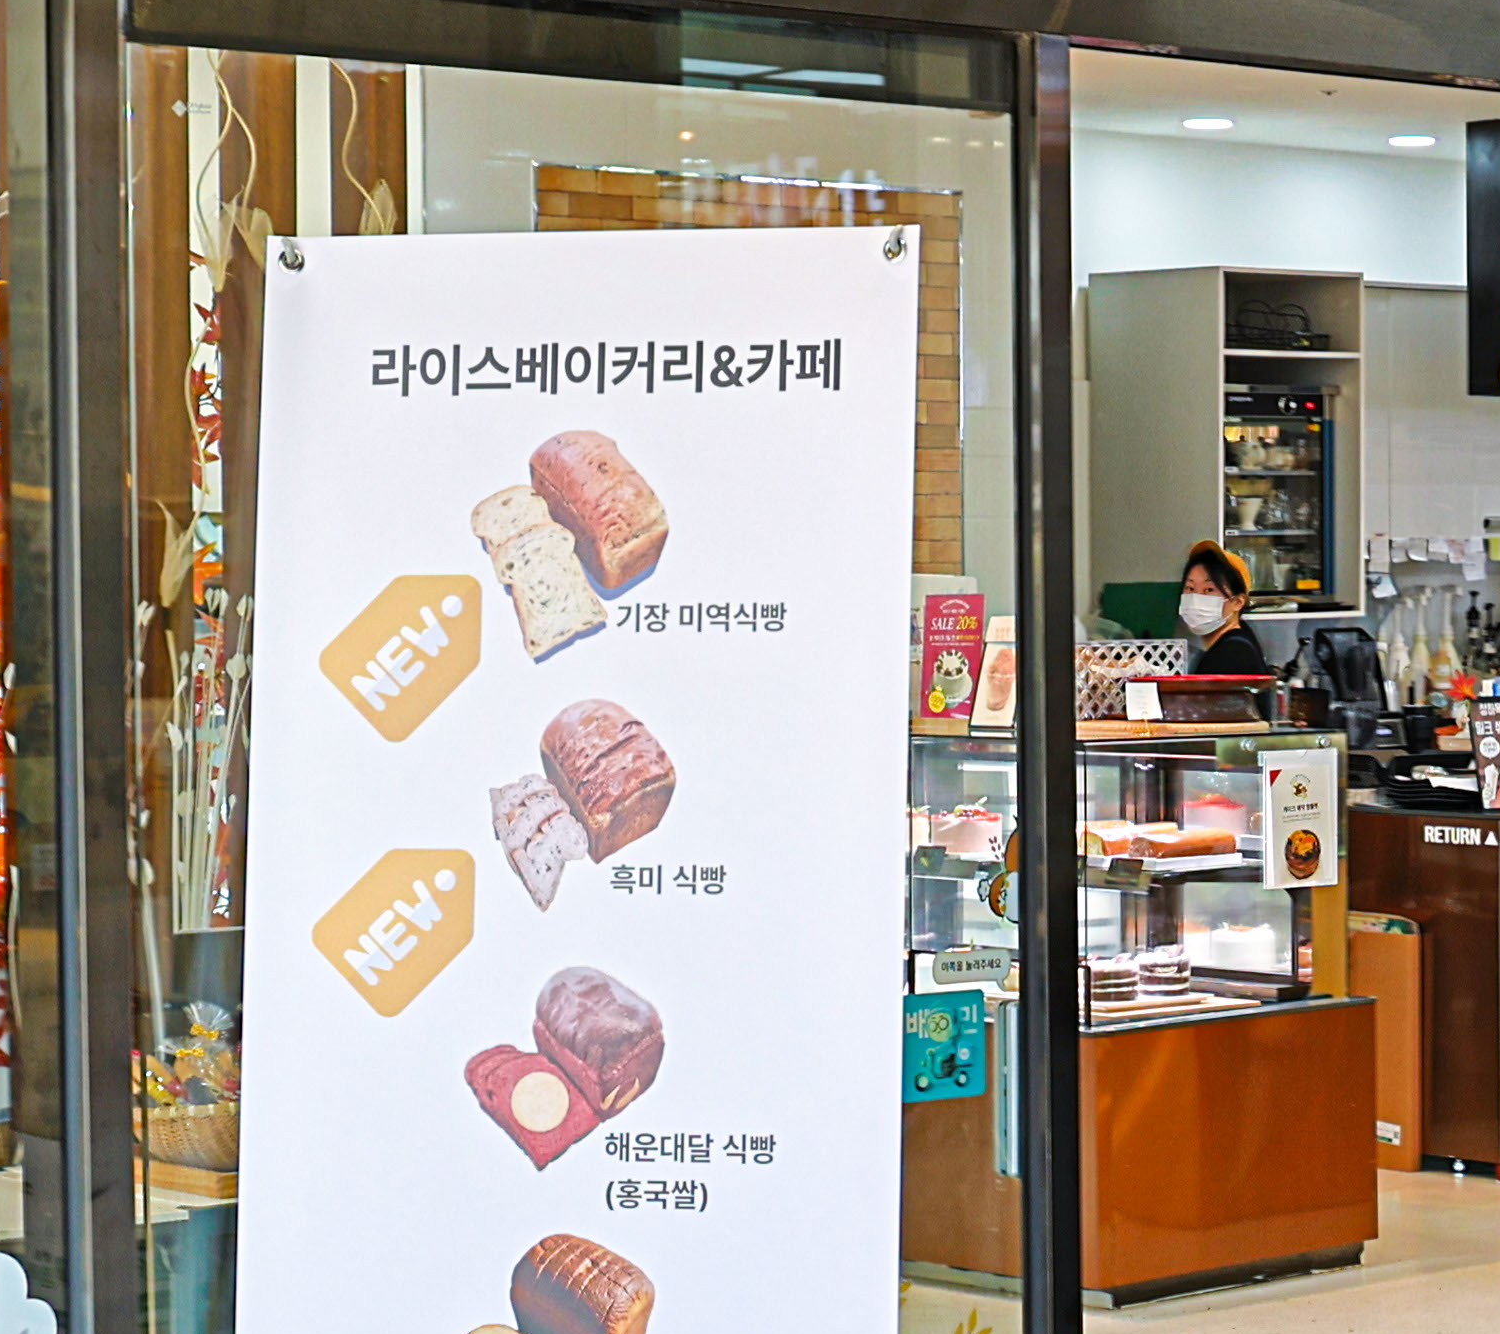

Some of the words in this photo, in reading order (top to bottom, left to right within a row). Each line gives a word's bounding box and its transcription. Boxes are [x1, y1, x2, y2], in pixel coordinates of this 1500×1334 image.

[371, 337, 843, 397] 라이스베이커리&카페
[615, 602, 670, 634] 기장
[678, 601, 788, 634] 미역식빵
[930, 617, 955, 631] SALE
[956, 615, 979, 630] 20%
[350, 604, 448, 712] NEW
[1424, 824, 1481, 847] RETURN
[608, 865, 664, 896] 흑미
[672, 864, 728, 896] 식빵
[343, 882, 443, 987] NEW
[603, 1133, 714, 1165] 해운대달
[722, 1132, 776, 1165] 식빵
[604, 1179, 709, 1212] (홍국쌀)
